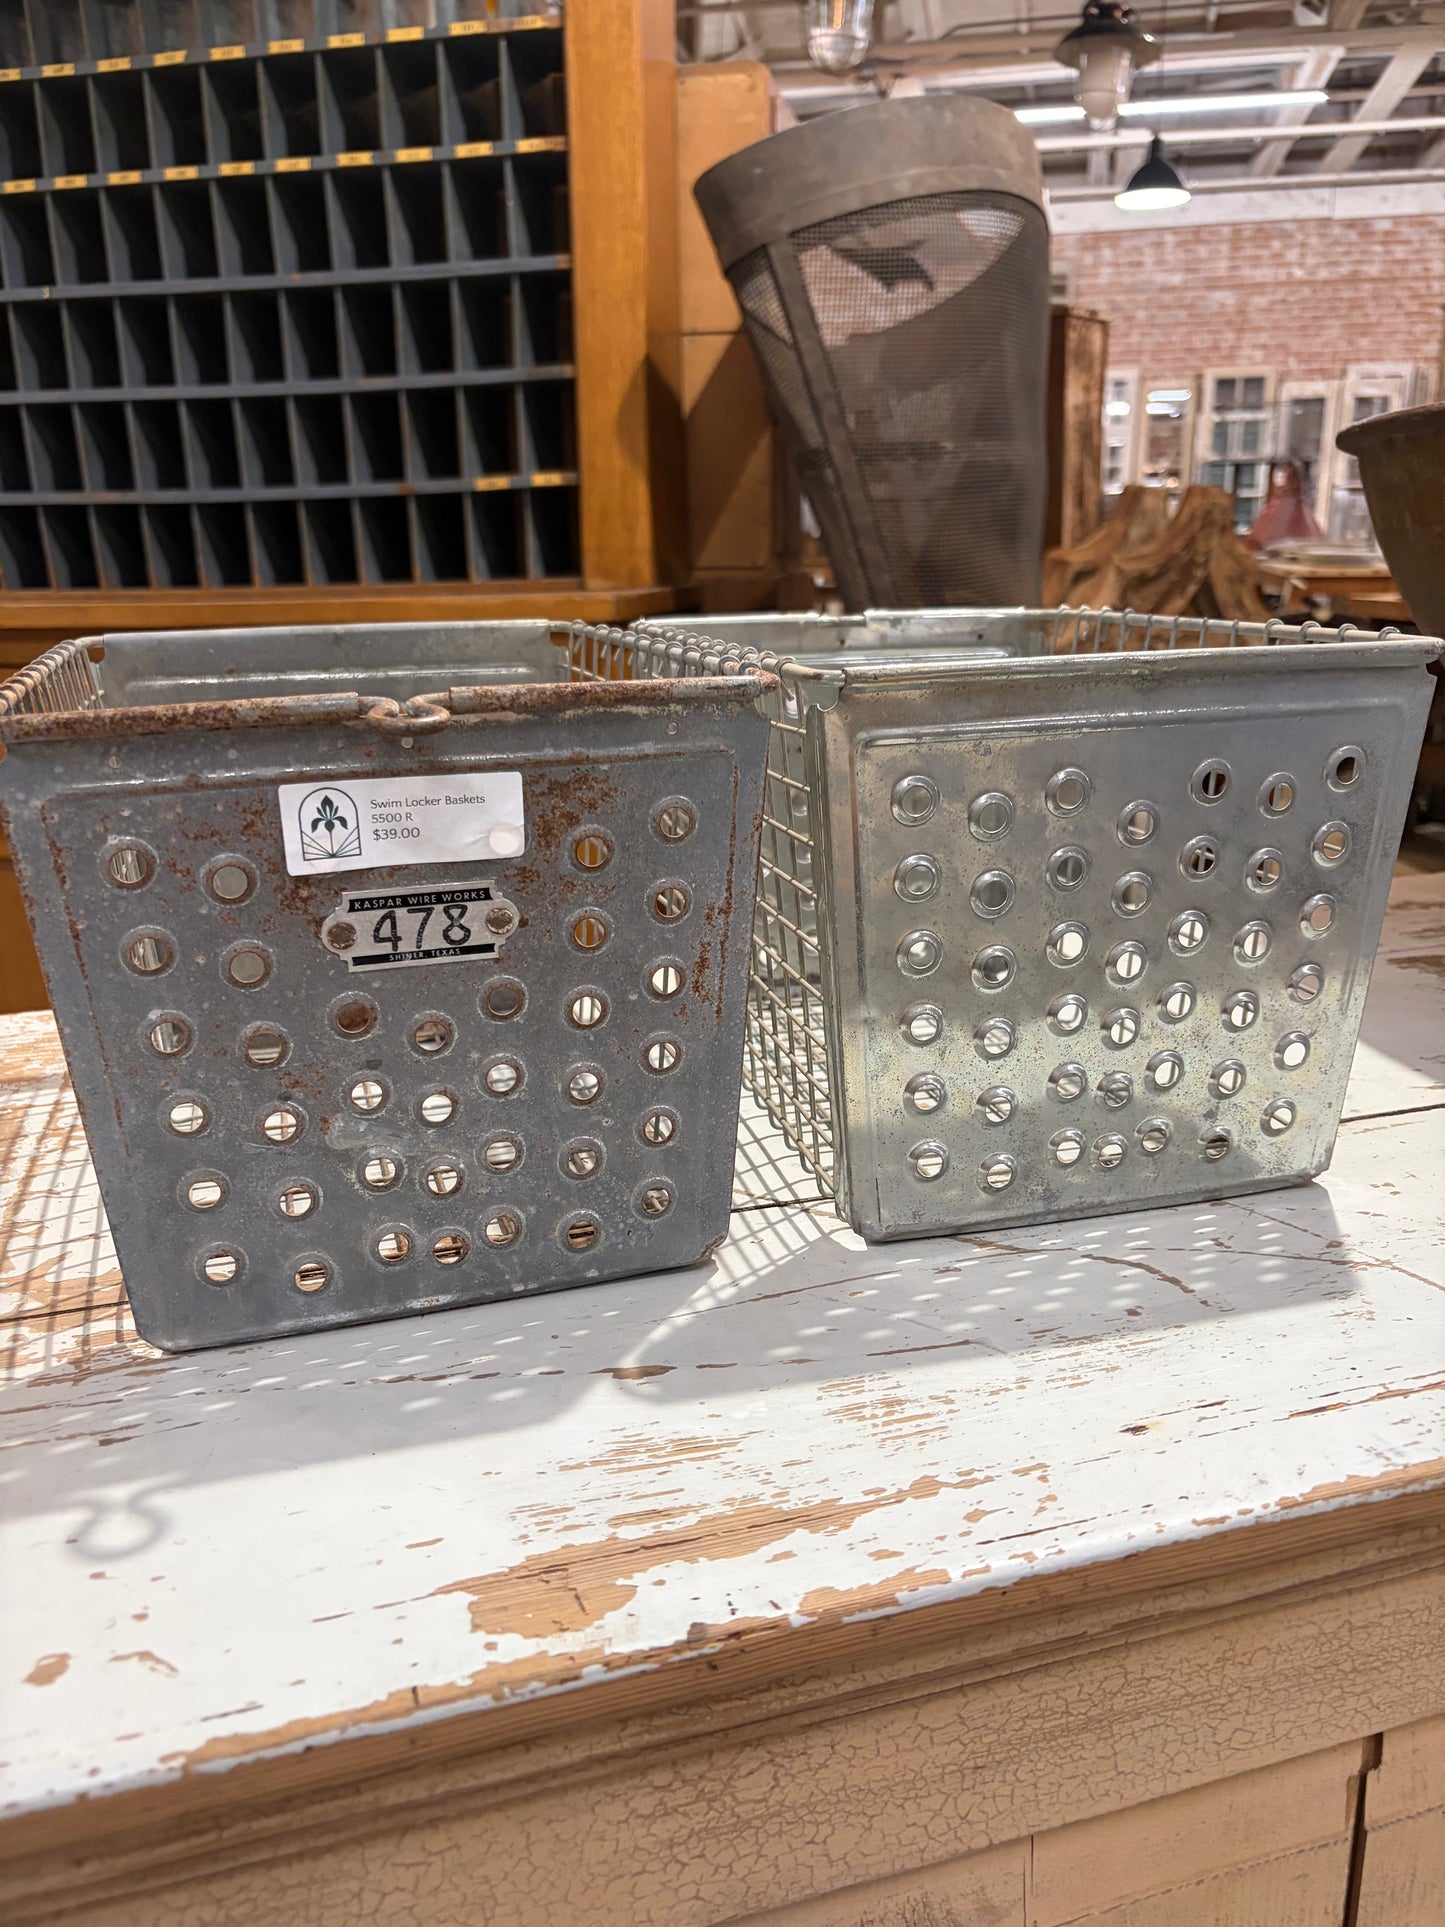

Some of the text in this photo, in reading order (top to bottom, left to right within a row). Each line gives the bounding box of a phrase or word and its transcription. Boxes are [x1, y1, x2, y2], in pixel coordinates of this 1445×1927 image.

[370, 794, 486, 809] Swim Locker Baskets
[371, 812, 414, 824] 5500 R
[373, 827, 421, 842] $39.00
[354, 890, 486, 910] KASPAR WIRE WORKS
[373, 904, 471, 952] 478
[431, 948, 461, 957] TEXAS
